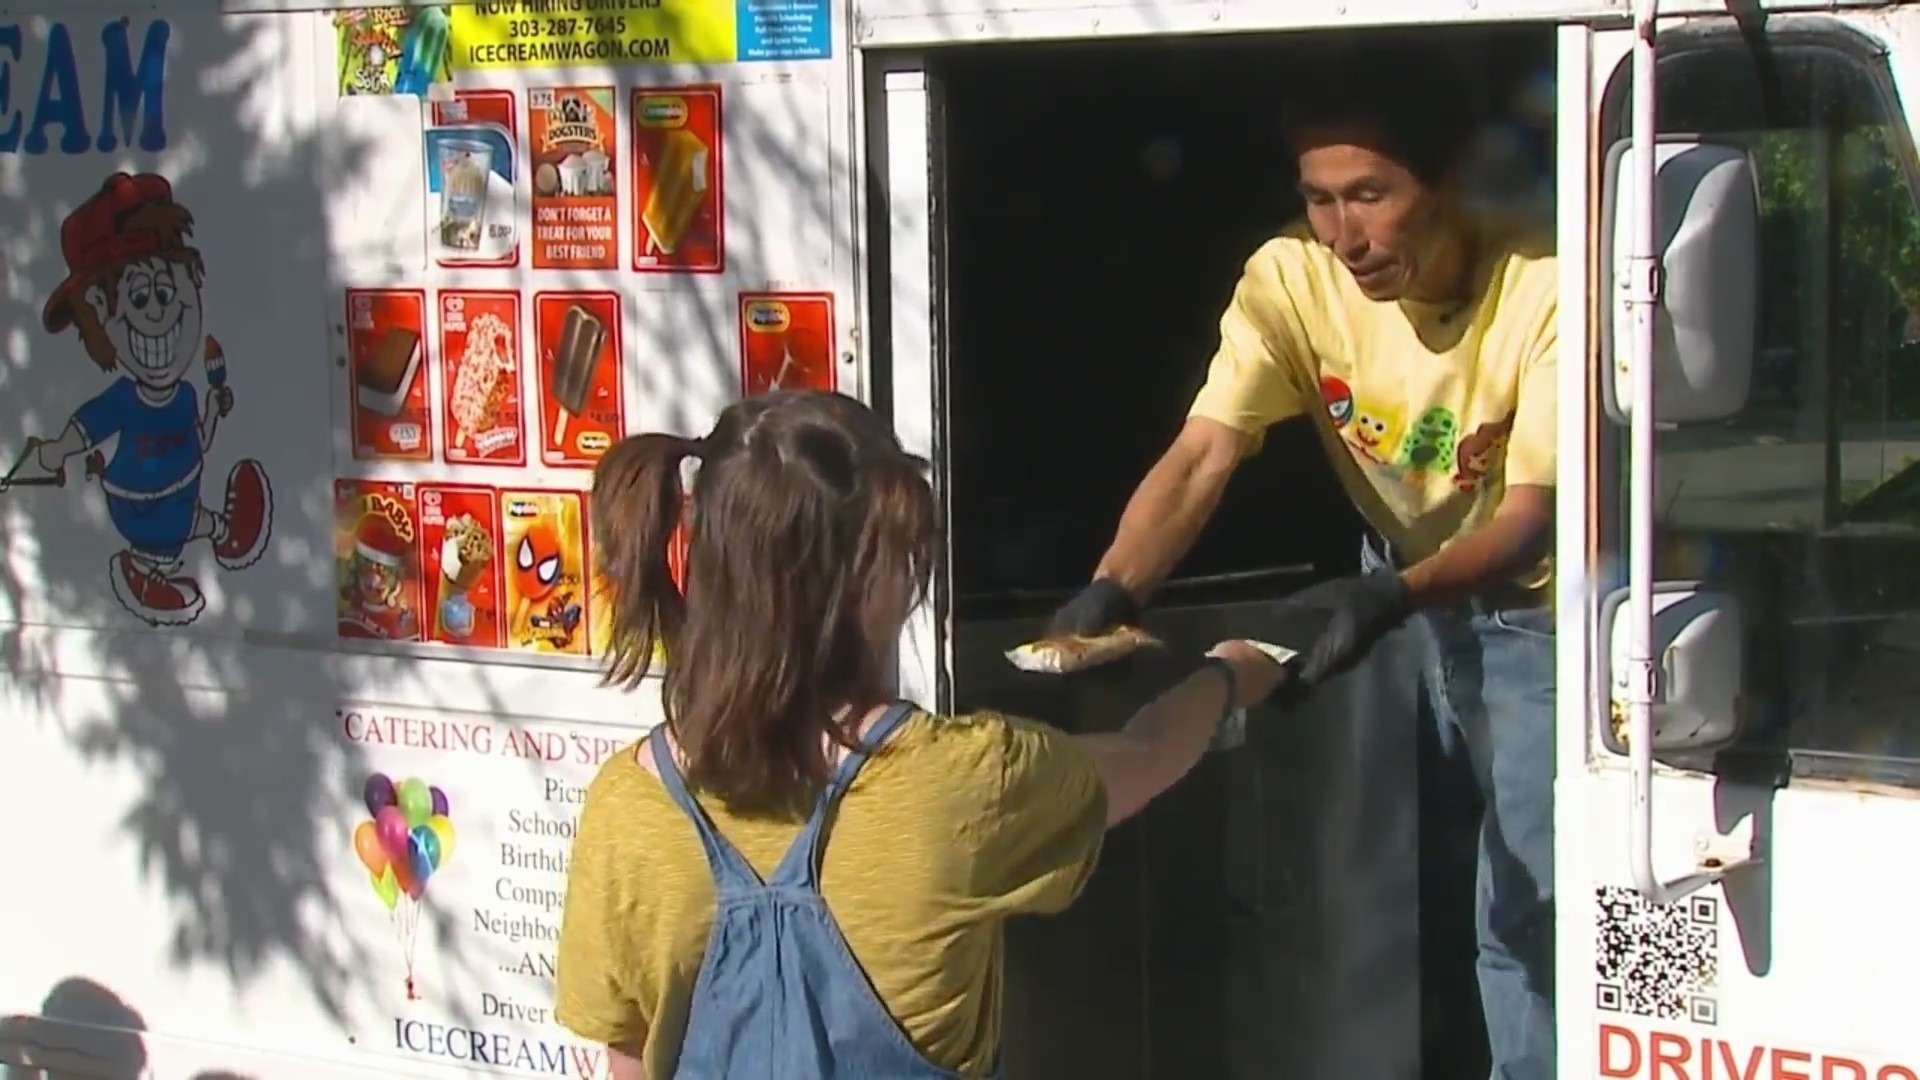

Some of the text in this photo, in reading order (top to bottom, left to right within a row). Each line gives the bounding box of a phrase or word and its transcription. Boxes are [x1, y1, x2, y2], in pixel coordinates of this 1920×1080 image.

[476, 0, 515, 15] NOW
[522, 0, 582, 13] HIRING
[509, 16, 626, 38] 303-287-7645
[469, 38, 670, 63] ICECREAMWAGON.COM
[537, 206, 612, 222] DON'T FORGET A
[536, 225, 613, 241] TREAT FOR YOUR
[545, 244, 606, 260] BEST FRIEND
[344, 712, 492, 754] CATERING
[500, 729, 567, 763] AND
[508, 808, 577, 838] School
[481, 992, 548, 1025] Driver
[1599, 1022, 1919, 1080] DRIVE
